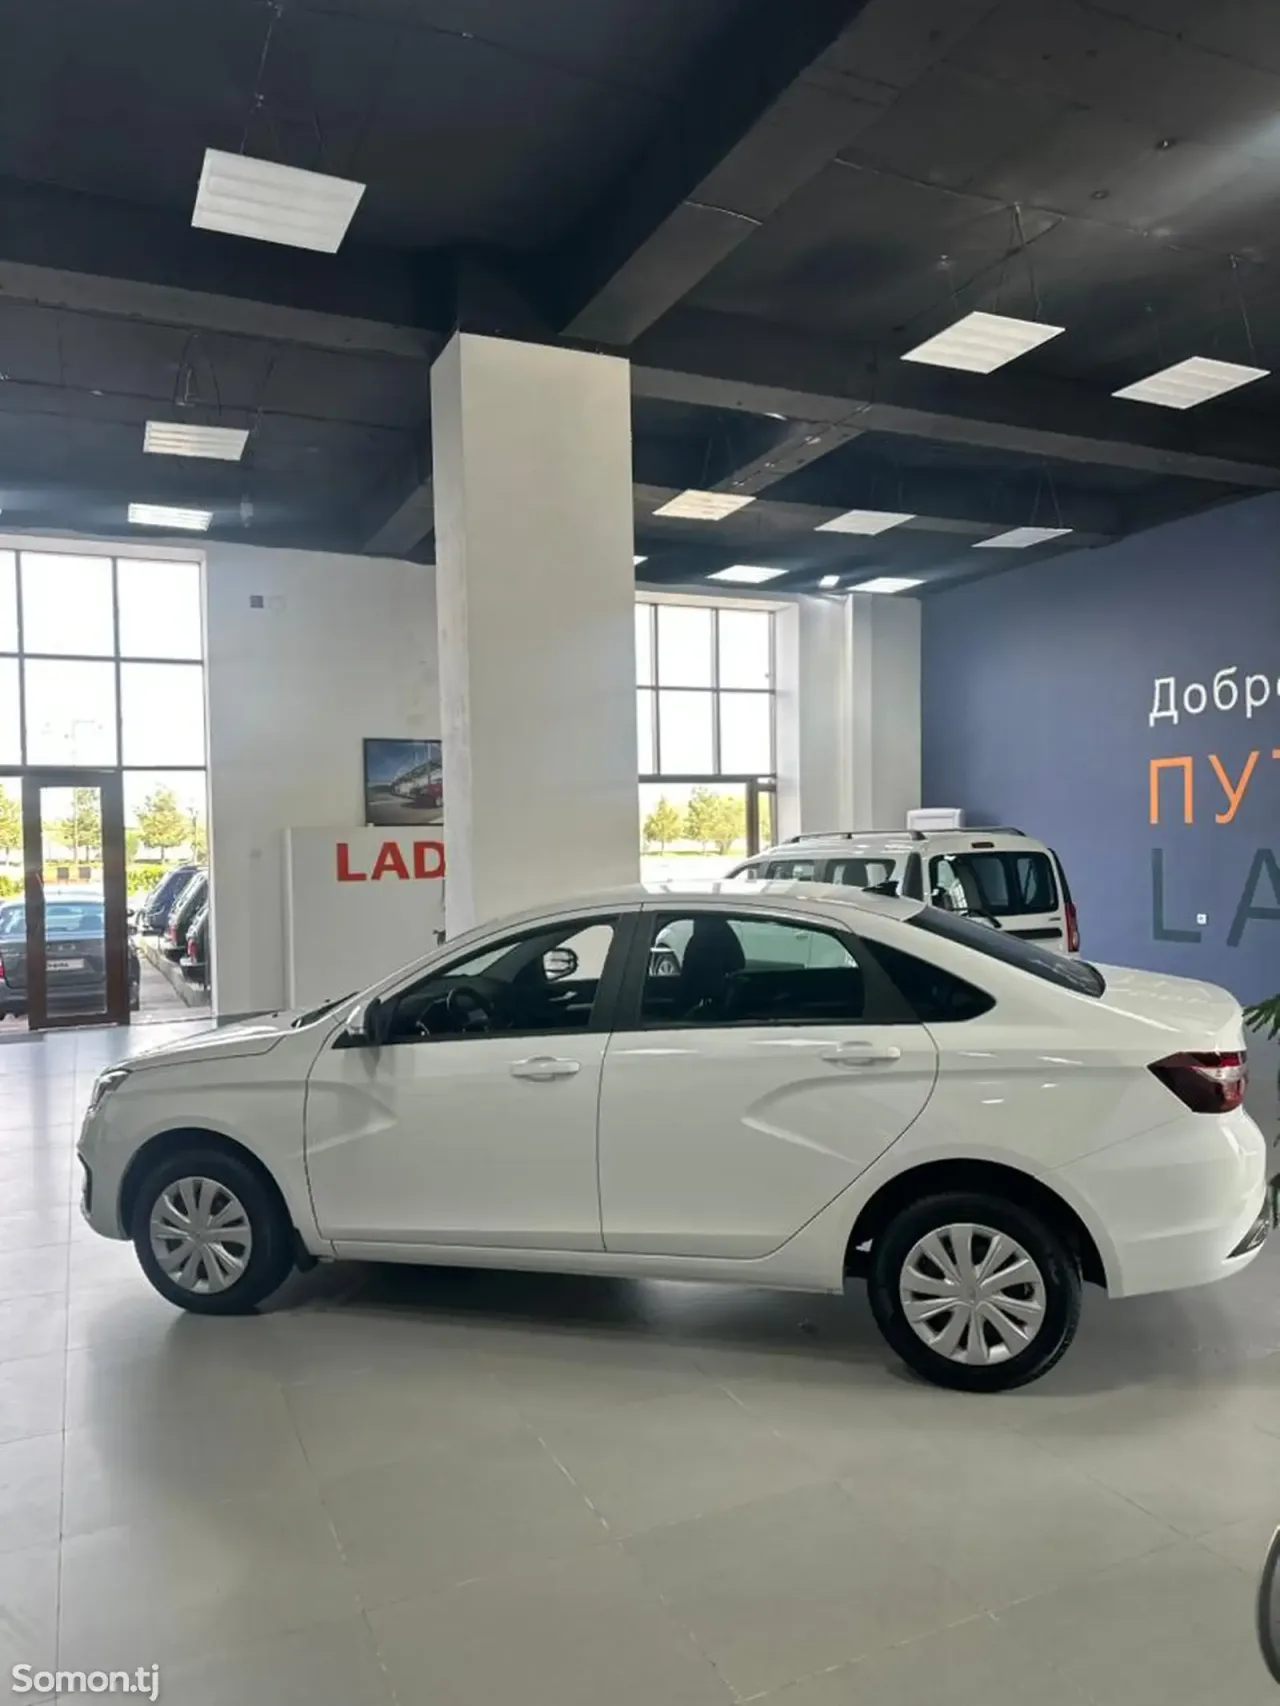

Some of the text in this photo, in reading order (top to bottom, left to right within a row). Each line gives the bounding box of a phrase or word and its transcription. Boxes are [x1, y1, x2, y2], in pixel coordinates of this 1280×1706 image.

[1149, 666, 1280, 727] Добр
[1150, 749, 1280, 824] ПУ
[336, 840, 446, 882] LAD
